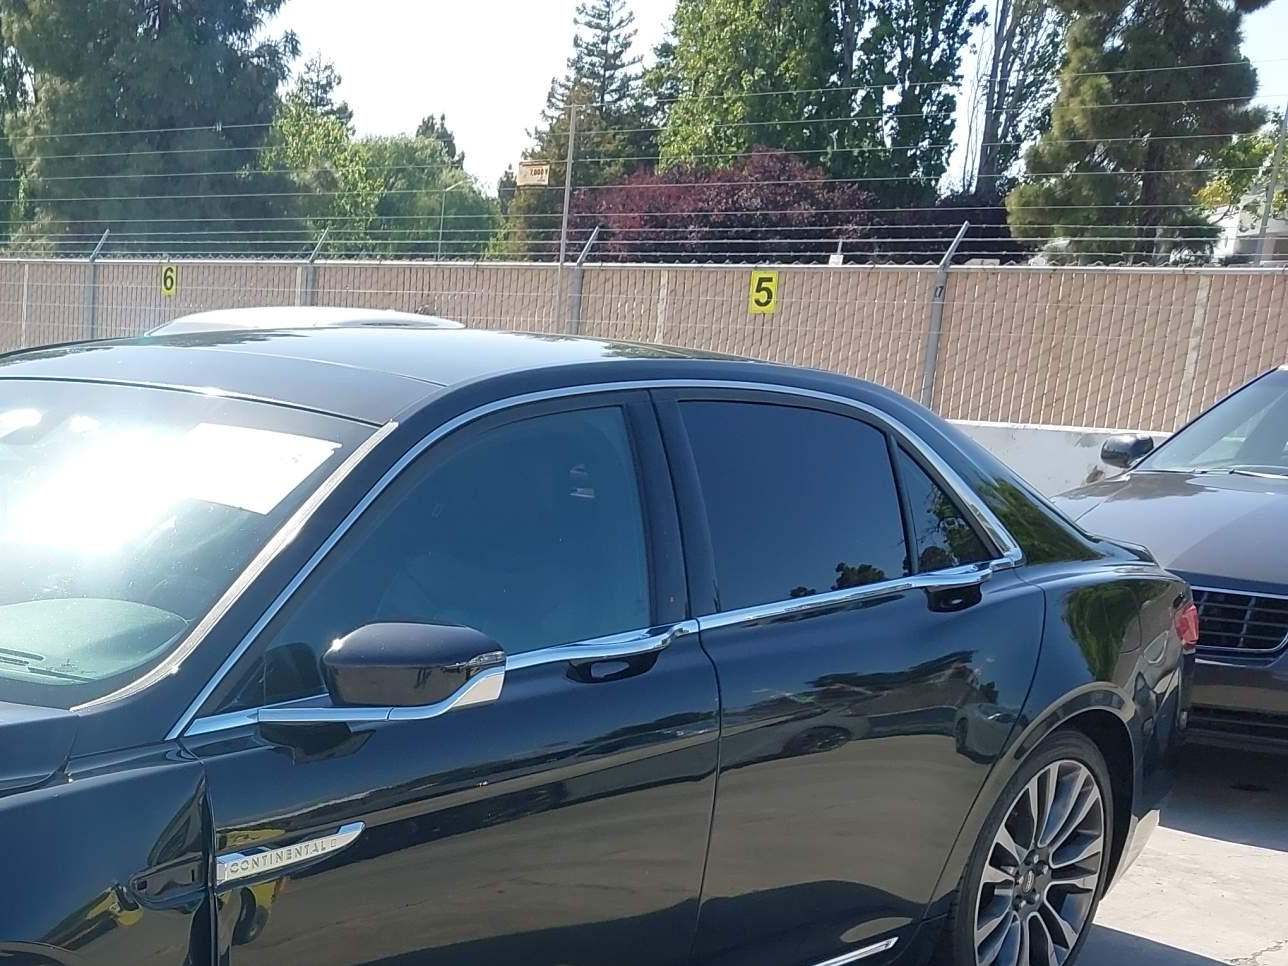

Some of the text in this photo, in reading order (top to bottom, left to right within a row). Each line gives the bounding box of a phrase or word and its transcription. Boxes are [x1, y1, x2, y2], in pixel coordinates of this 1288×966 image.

[163, 266, 174, 291] 6
[754, 276, 774, 307] 5
[229, 840, 328, 874] CONTINENTAL
